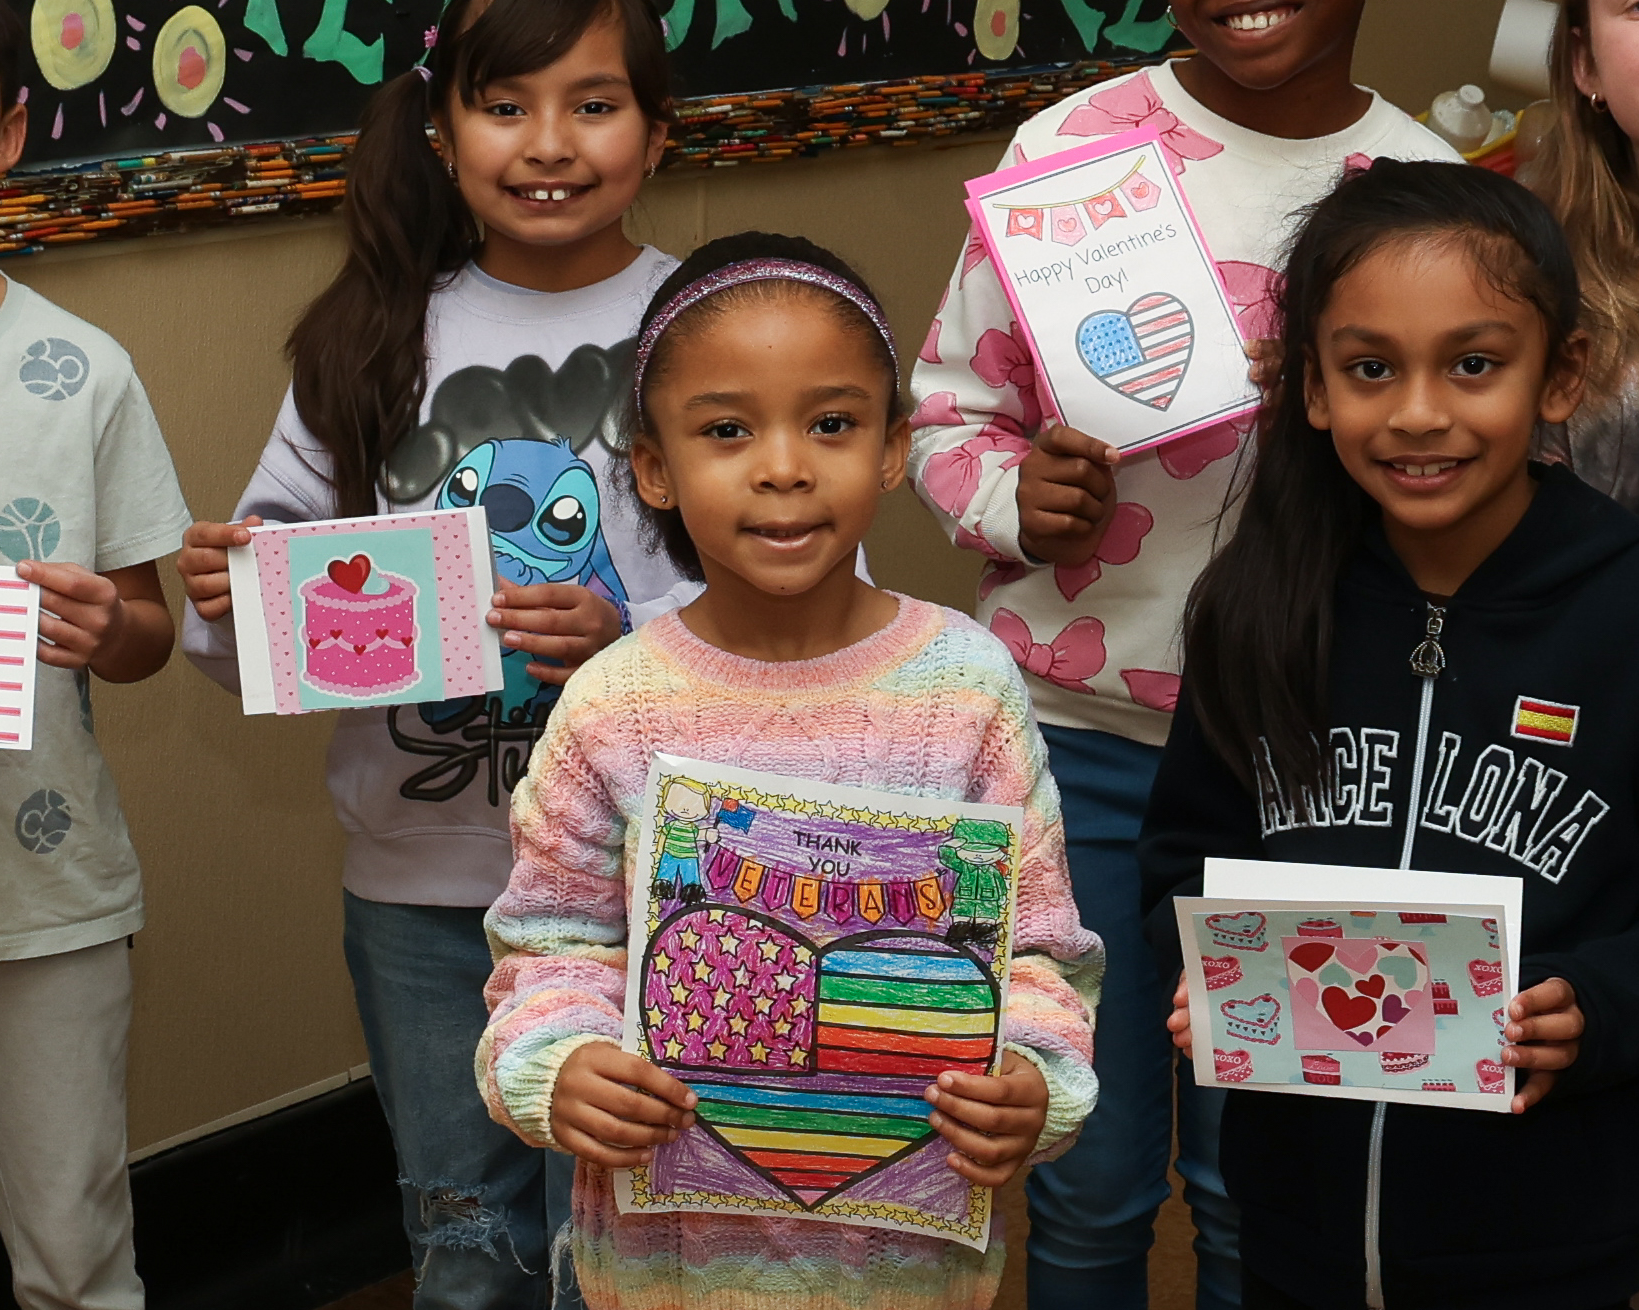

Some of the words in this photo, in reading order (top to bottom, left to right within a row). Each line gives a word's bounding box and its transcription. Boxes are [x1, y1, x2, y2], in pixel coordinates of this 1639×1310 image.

[1013, 257, 1075, 287] Happy
[1075, 223, 1177, 266] Valentine's
[1084, 267, 1130, 295] Day!
[792, 830, 863, 856] THANK
[808, 856, 851, 878] YOU
[716, 850, 937, 913] VETERANS
